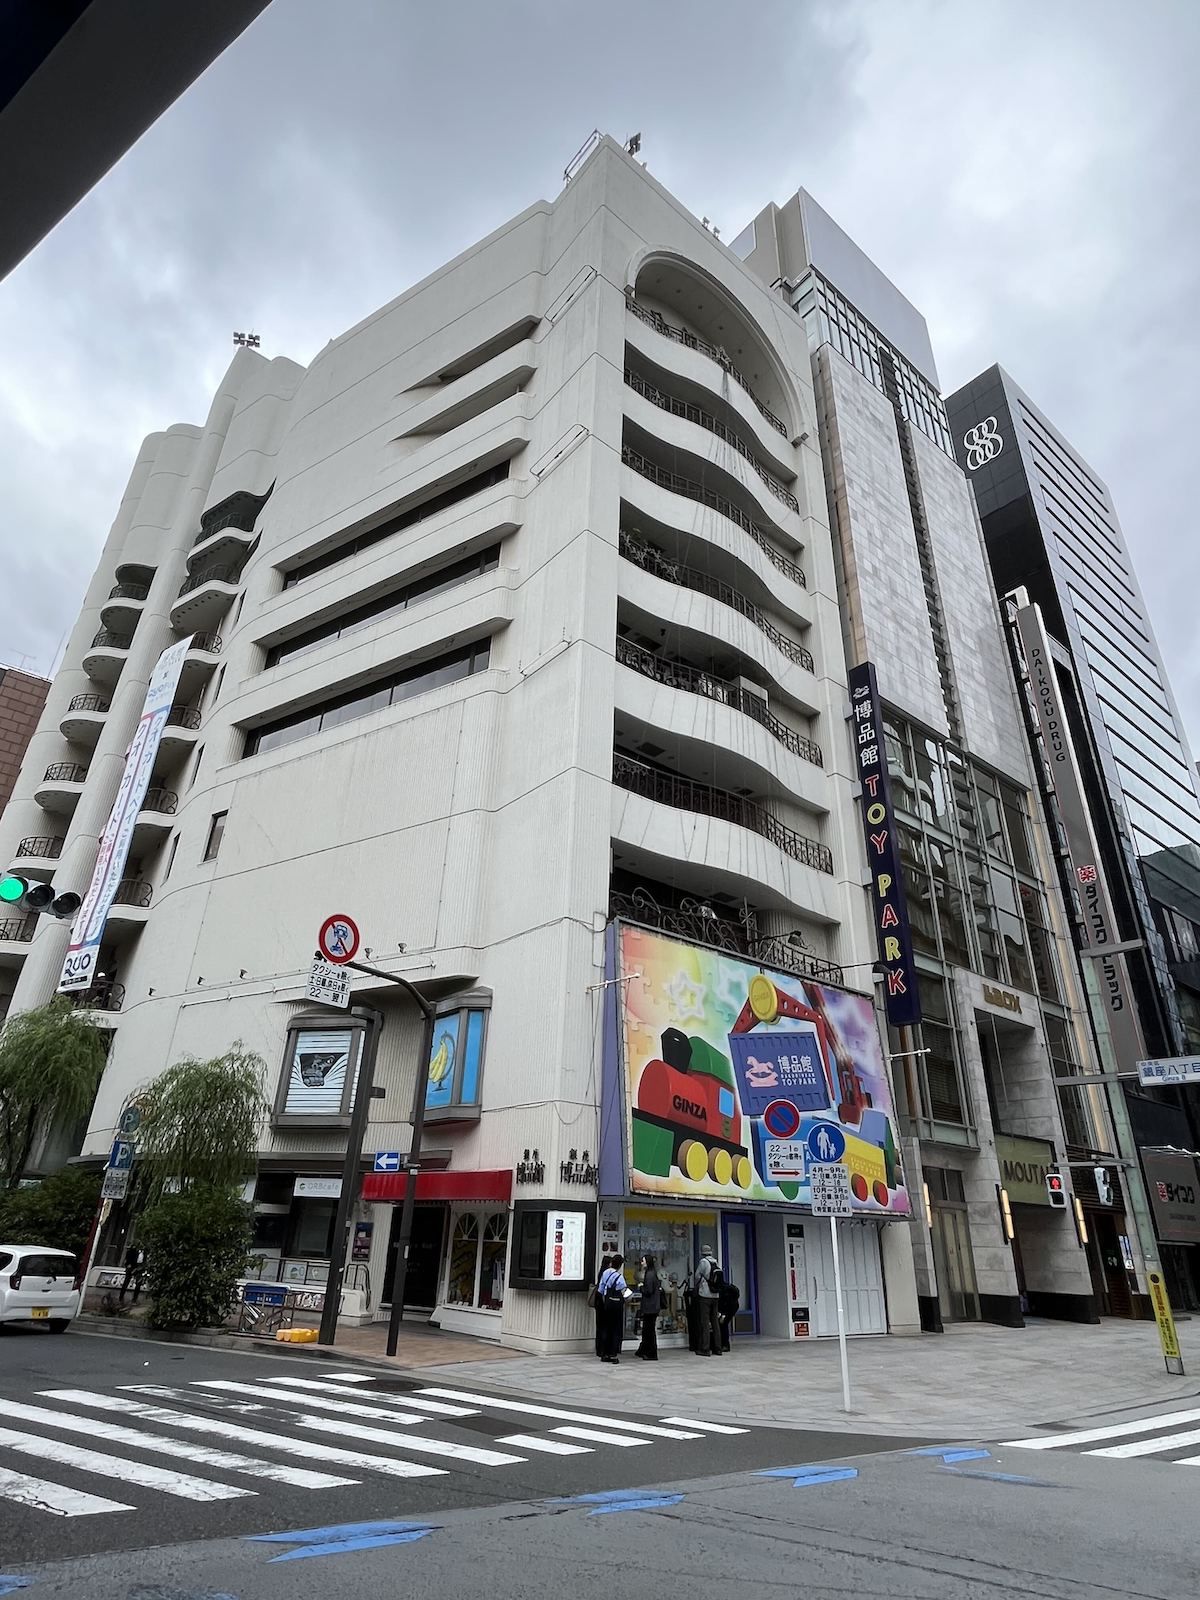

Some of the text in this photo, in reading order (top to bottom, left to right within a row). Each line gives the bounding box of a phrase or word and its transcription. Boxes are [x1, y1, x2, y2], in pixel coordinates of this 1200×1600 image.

[1031, 648, 1065, 762] DAIKOKU DRUG
[854, 700, 907, 996] 博品館 TOY PARK
[64, 952, 91, 979] QUO
[777, 1055, 814, 1074] 博品館
[781, 1078, 817, 1087] TOY PARK
[672, 1094, 707, 1121] GINZA
[516, 1160, 546, 1184] 博品館
[560, 1160, 599, 1186] 博品館
[1166, 1182, 1195, 1204] ダイコク
